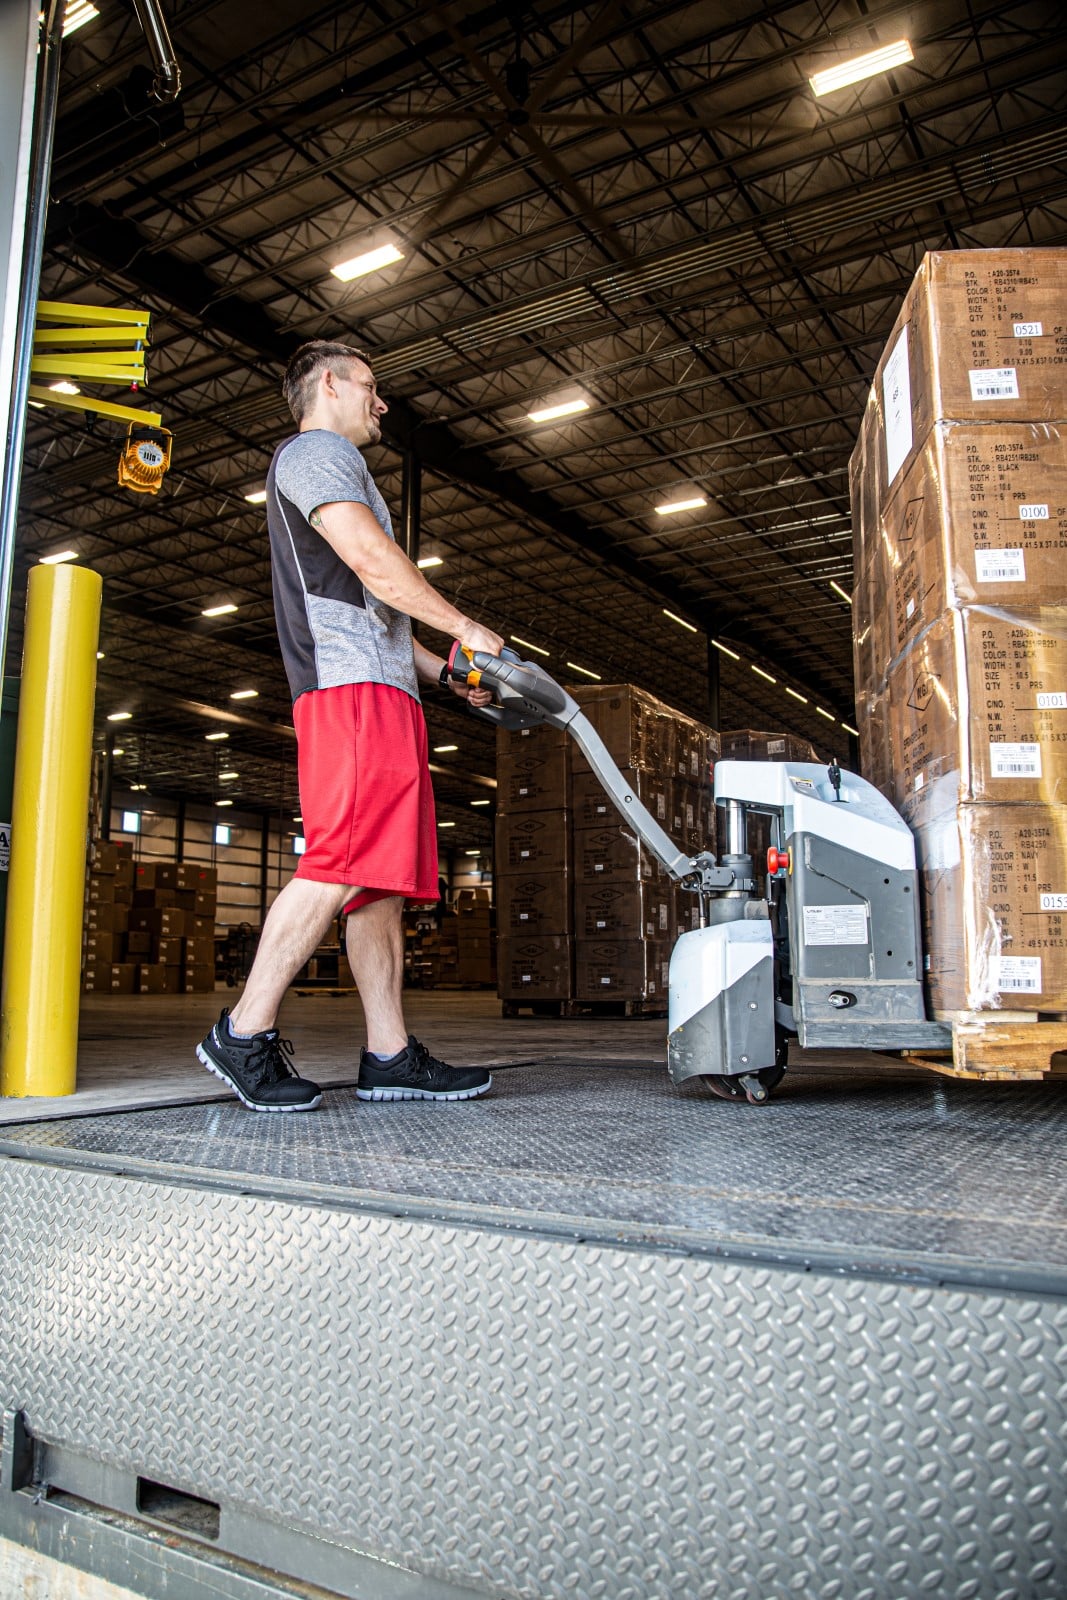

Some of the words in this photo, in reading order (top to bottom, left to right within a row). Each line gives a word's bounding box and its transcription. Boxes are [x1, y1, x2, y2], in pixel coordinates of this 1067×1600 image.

[969, 305, 983, 313] SIZE
[1015, 325, 1039, 335] 0521
[968, 465, 991, 473] COLOR
[997, 463, 1020, 471] BLACK
[968, 474, 990, 482] WIDTH
[1012, 492, 1026, 500] PRS
[1021, 506, 1047, 517] 0100
[1057, 508, 1066, 516] OF
[983, 651, 1007, 659] COLOR
[1014, 651, 1035, 659] BLACK
[984, 662, 1006, 670] WIDTH
[985, 672, 1000, 680] SIZE
[1029, 681, 1043, 689] PRS
[1038, 695, 1064, 706] 0101
[990, 852, 1014, 861] COLOR
[1021, 851, 1039, 859] NAVY
[991, 863, 1013, 872] WIDTH
[991, 874, 1007, 882] SIZE
[1024, 873, 1037, 882] 11.5
[1037, 883, 1052, 892] PRS
